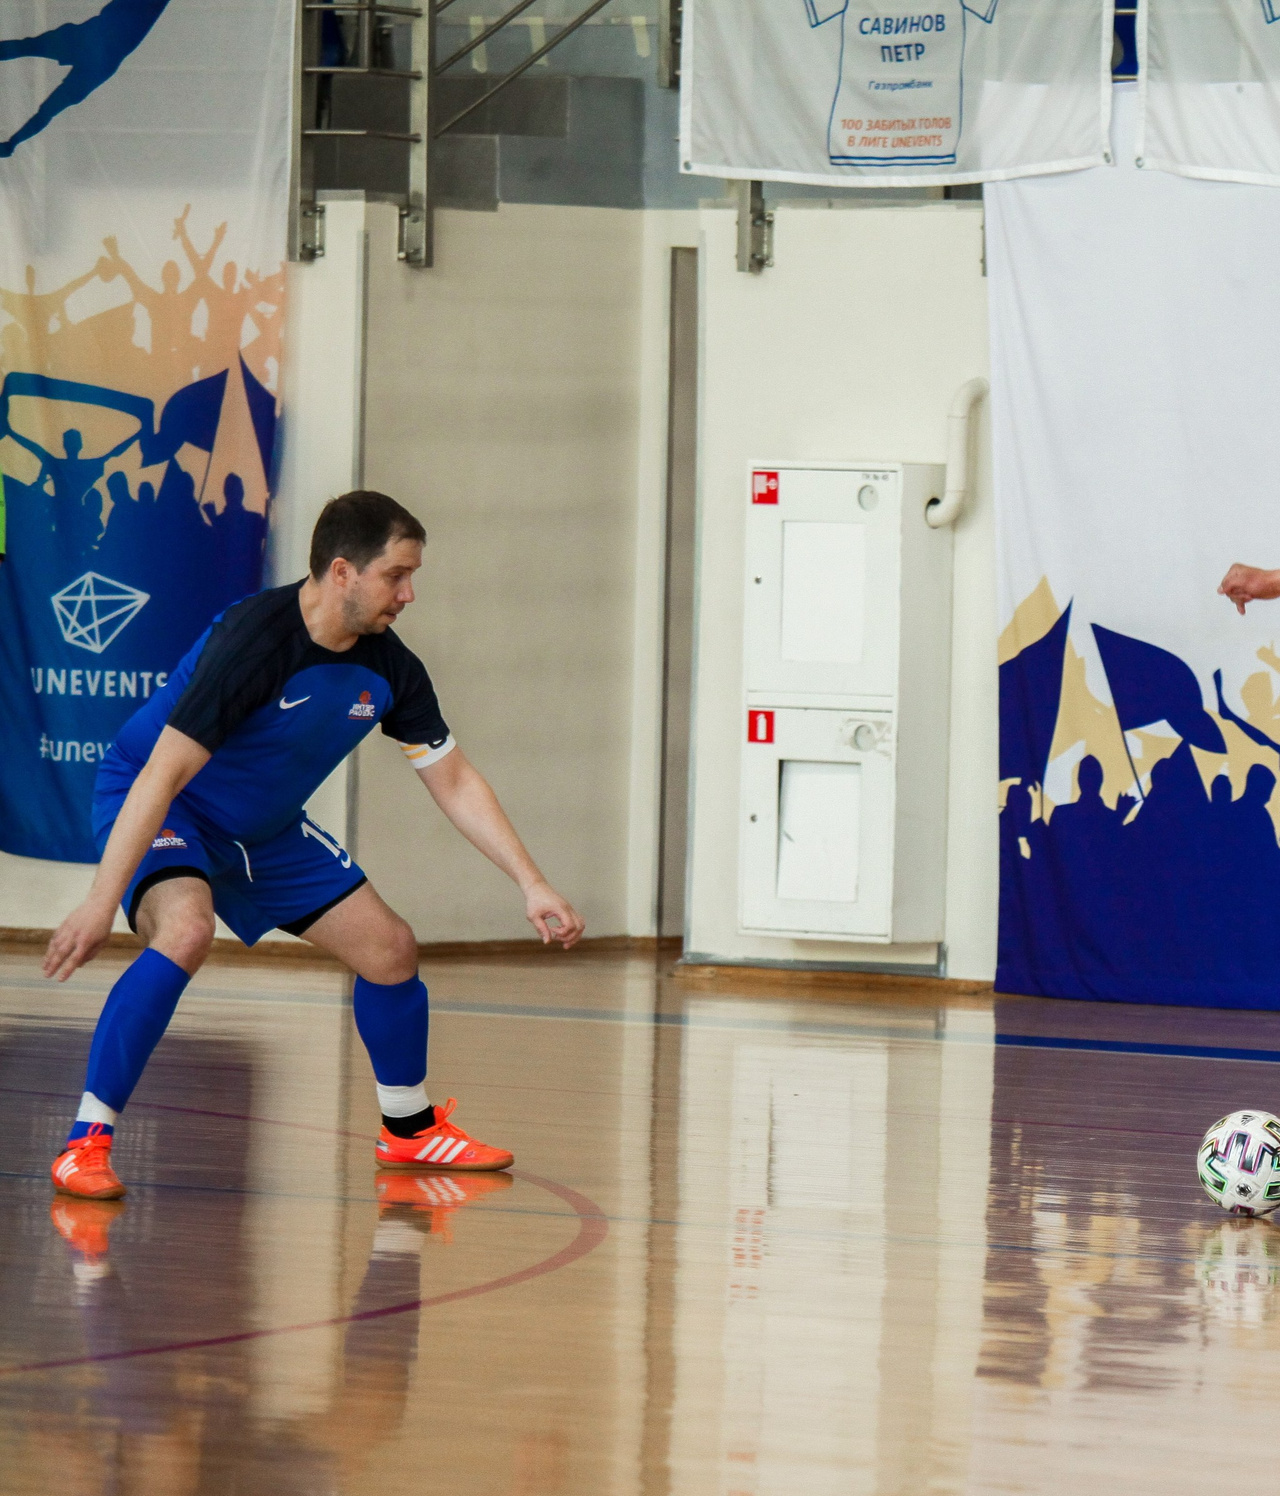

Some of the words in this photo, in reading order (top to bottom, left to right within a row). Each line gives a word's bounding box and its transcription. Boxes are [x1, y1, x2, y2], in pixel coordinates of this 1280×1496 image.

[859, 14, 946, 35] САВИНОВ
[880, 43, 926, 62] ПЕТР
[868, 79, 933, 92] Газпромбанк
[841, 119, 863, 130] 100
[866, 118, 916, 131] ЗАБИТЫХ
[918, 117, 952, 129] ГОЛОВ
[847, 136, 855, 147] В
[859, 136, 888, 148] ЛИГЕ
[891, 134, 943, 148] UNEVENTS
